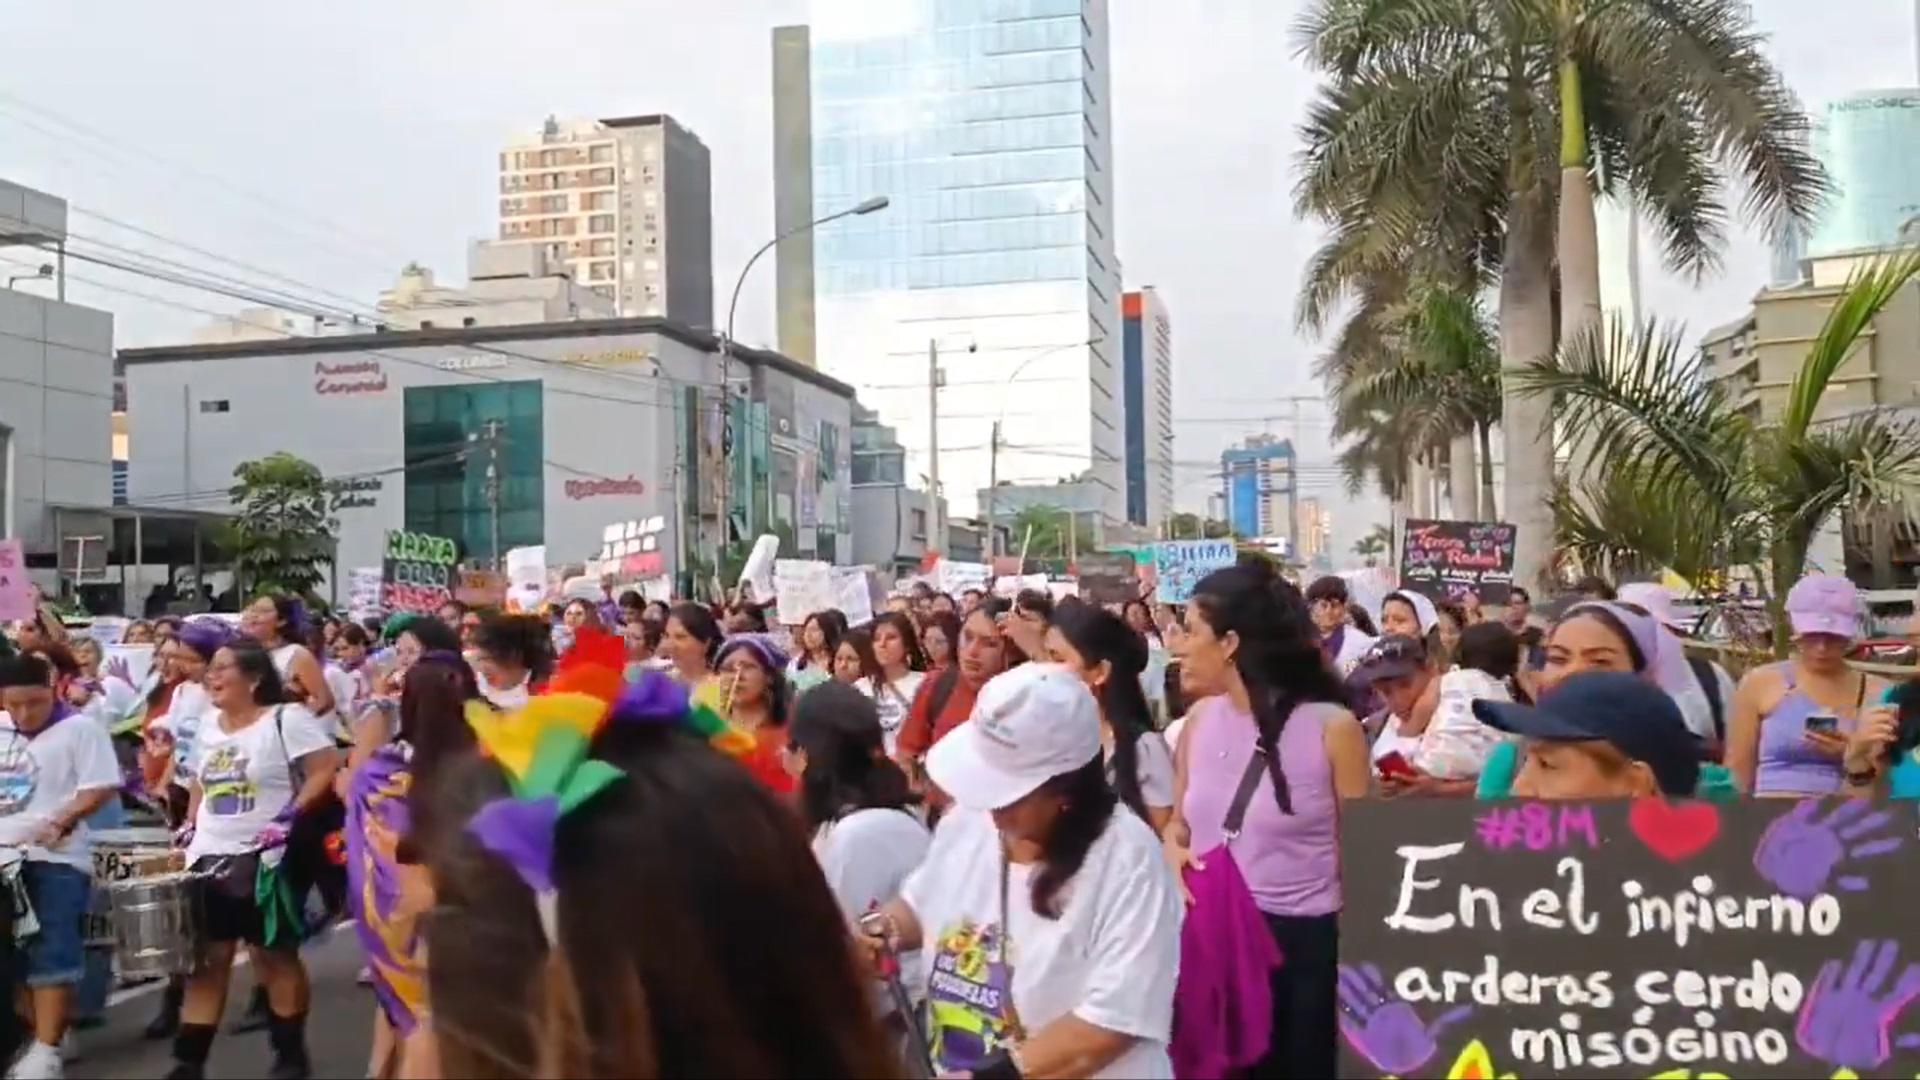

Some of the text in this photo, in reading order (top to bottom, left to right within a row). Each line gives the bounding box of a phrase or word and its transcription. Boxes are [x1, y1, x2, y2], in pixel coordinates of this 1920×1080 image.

[1473, 802, 1597, 848] #8M
[1384, 841, 1841, 947] En el infierno
[1394, 954, 1804, 1014] arderas cerdo
